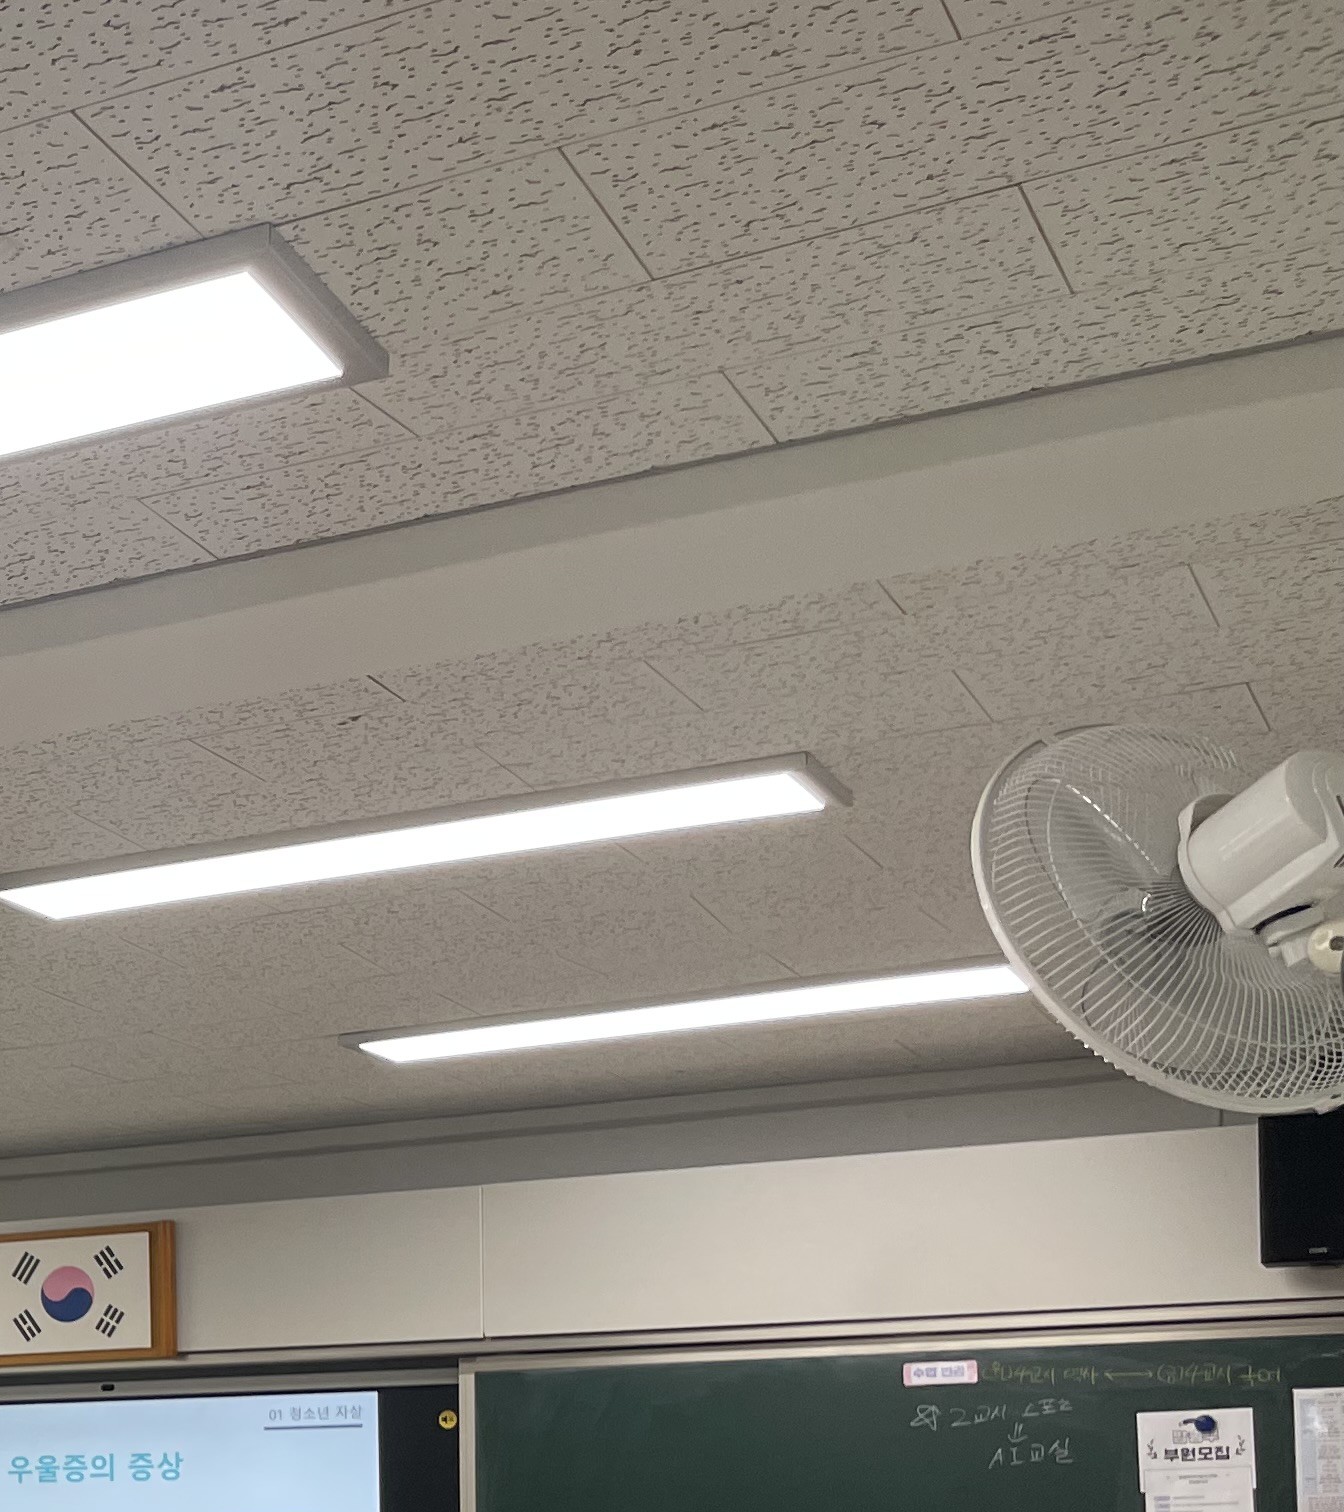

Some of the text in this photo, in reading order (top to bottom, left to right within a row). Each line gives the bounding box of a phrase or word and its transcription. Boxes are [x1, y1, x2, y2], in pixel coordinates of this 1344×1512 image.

[268, 1403, 364, 1422] 01 청소년 자살
[1163, 1446, 1231, 1463] 부원모집
[7, 1453, 116, 1485] 우울증의
[127, 1450, 185, 1483] 증상
